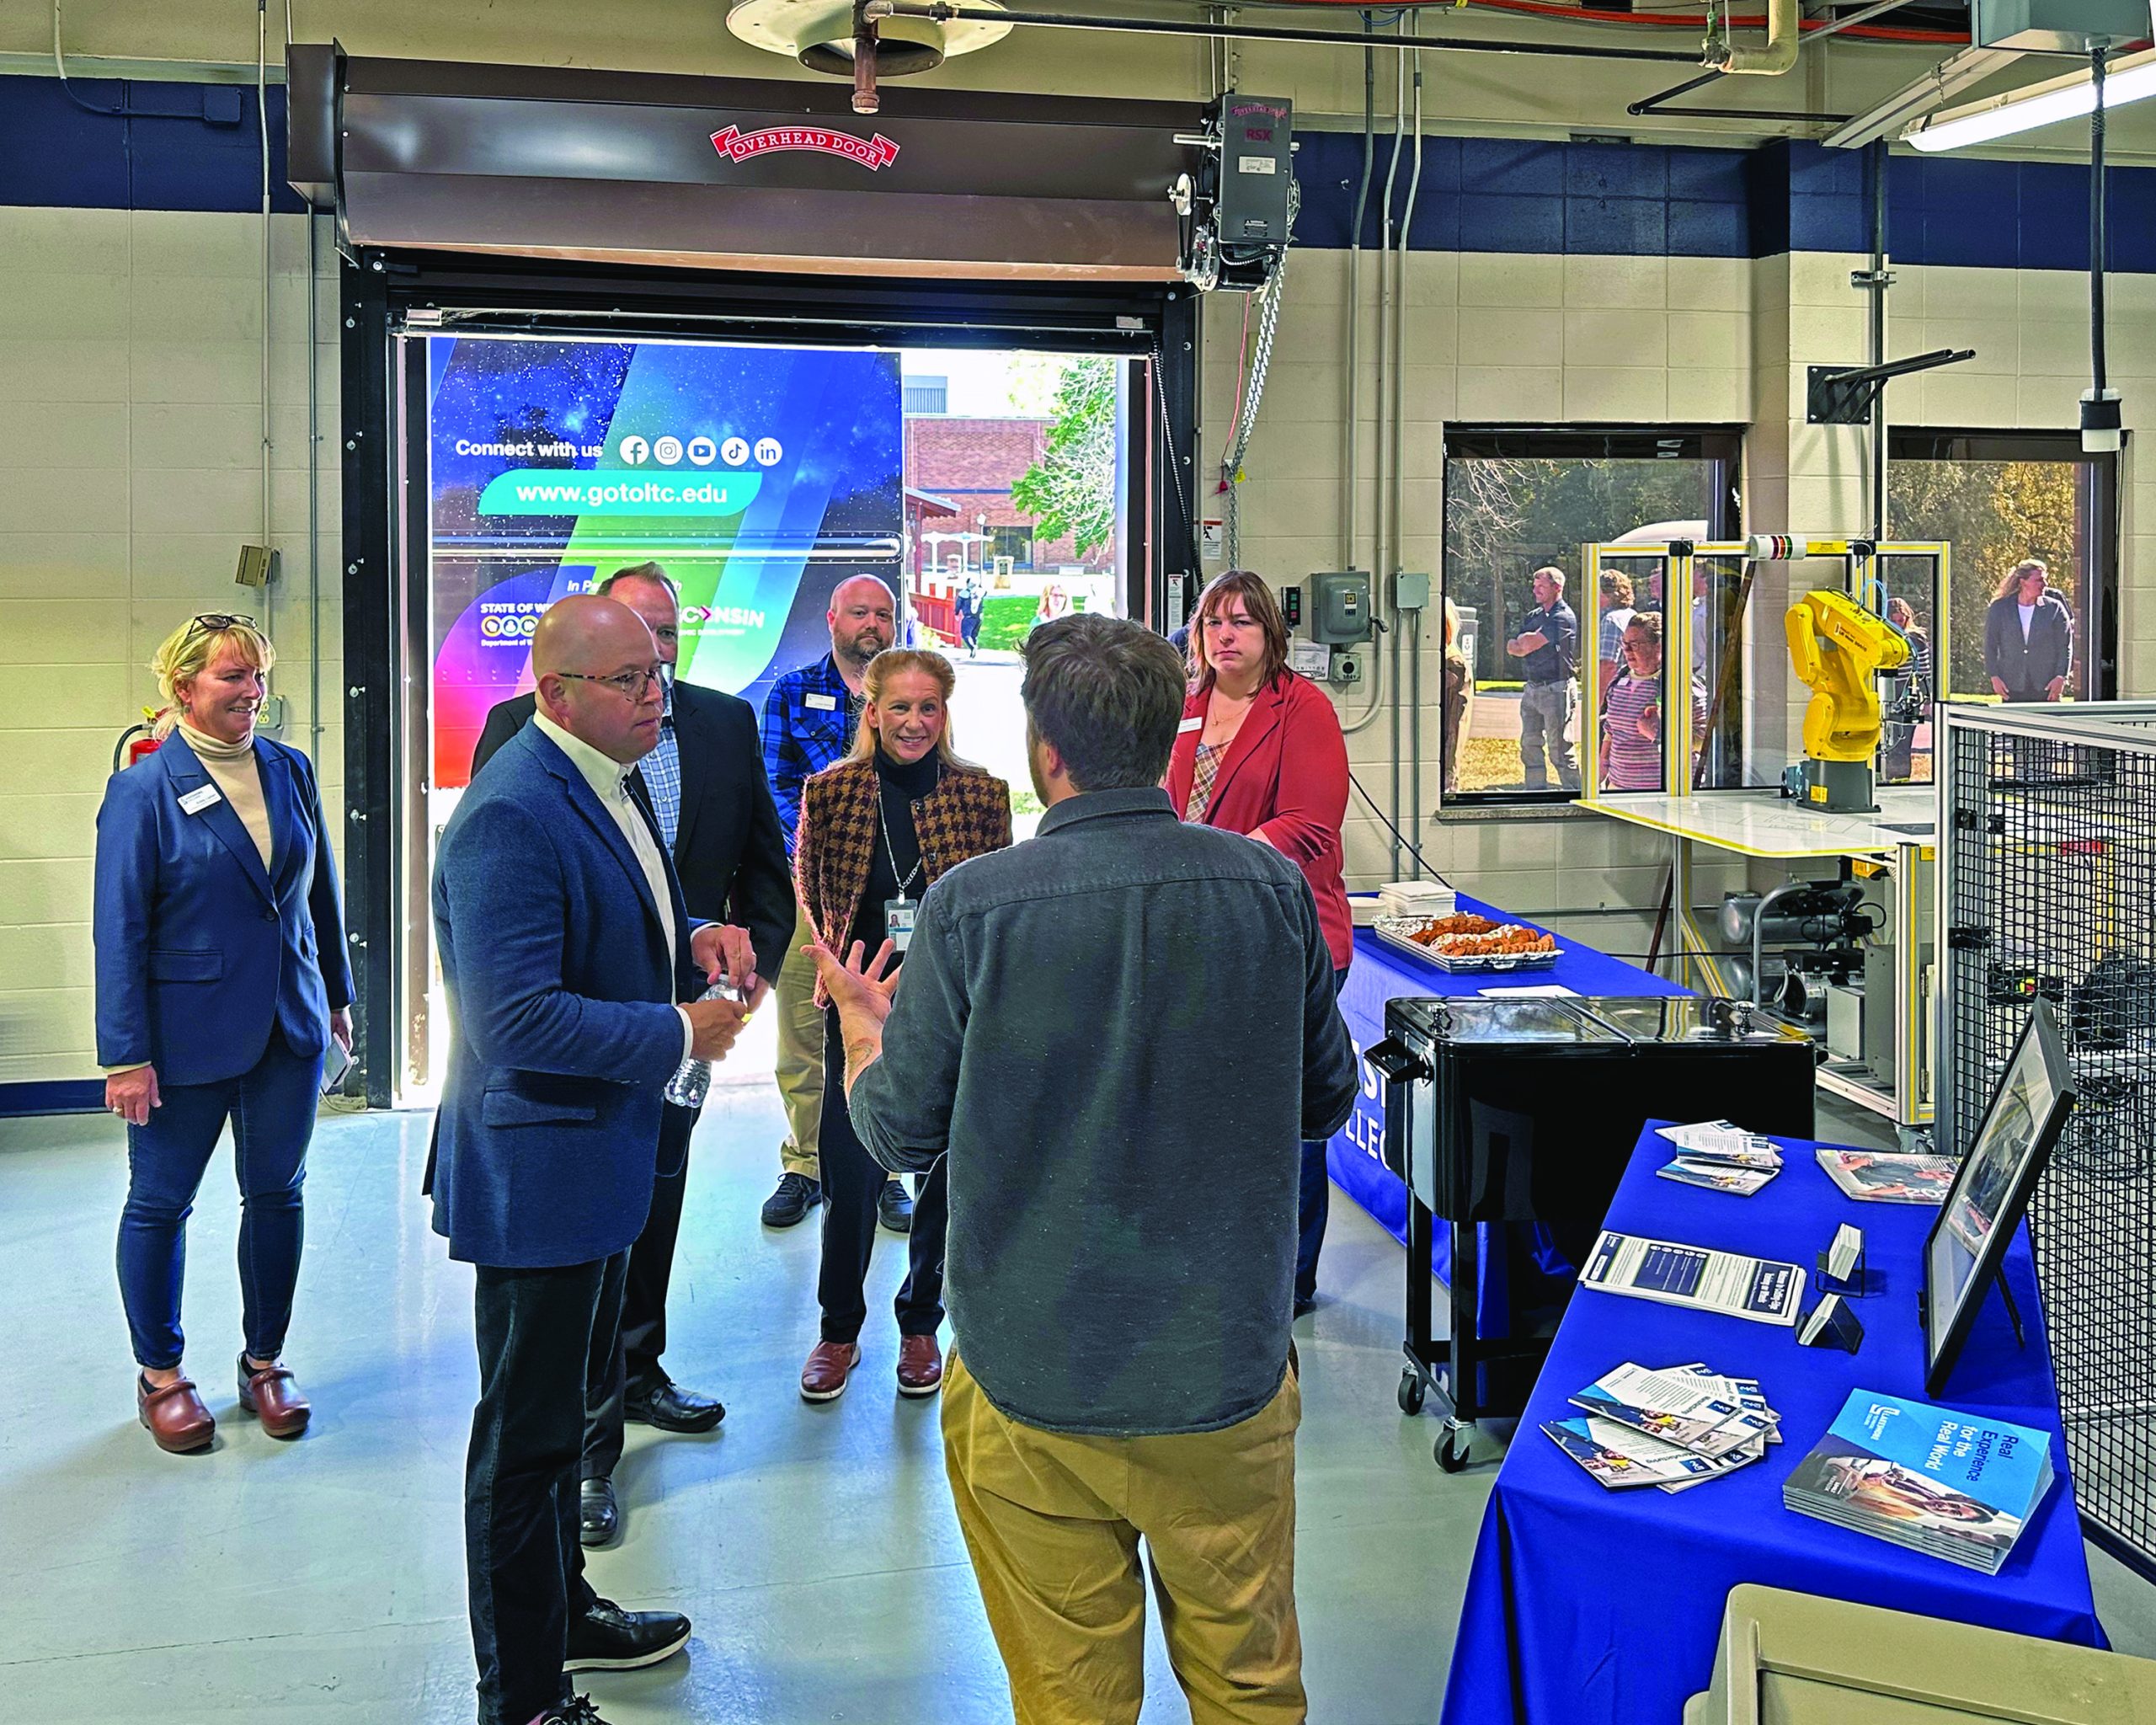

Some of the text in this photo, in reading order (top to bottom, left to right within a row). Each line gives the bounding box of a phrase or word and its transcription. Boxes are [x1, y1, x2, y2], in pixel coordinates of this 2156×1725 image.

[734, 132, 877, 163] OVERHEAD DOOR
[1246, 129, 1272, 142] RSX
[456, 440, 604, 457] Connect with us
[515, 483, 728, 507] www.gotoltc.edu
[567, 580, 579, 592] In
[481, 603, 515, 613] STATE
[516, 603, 534, 613] OF
[1924, 1420, 1959, 1471] Real World
[1952, 1425, 1979, 1458] for the
[1997, 1434, 2019, 1461] Real
[1966, 1429, 1999, 1482] Experience
